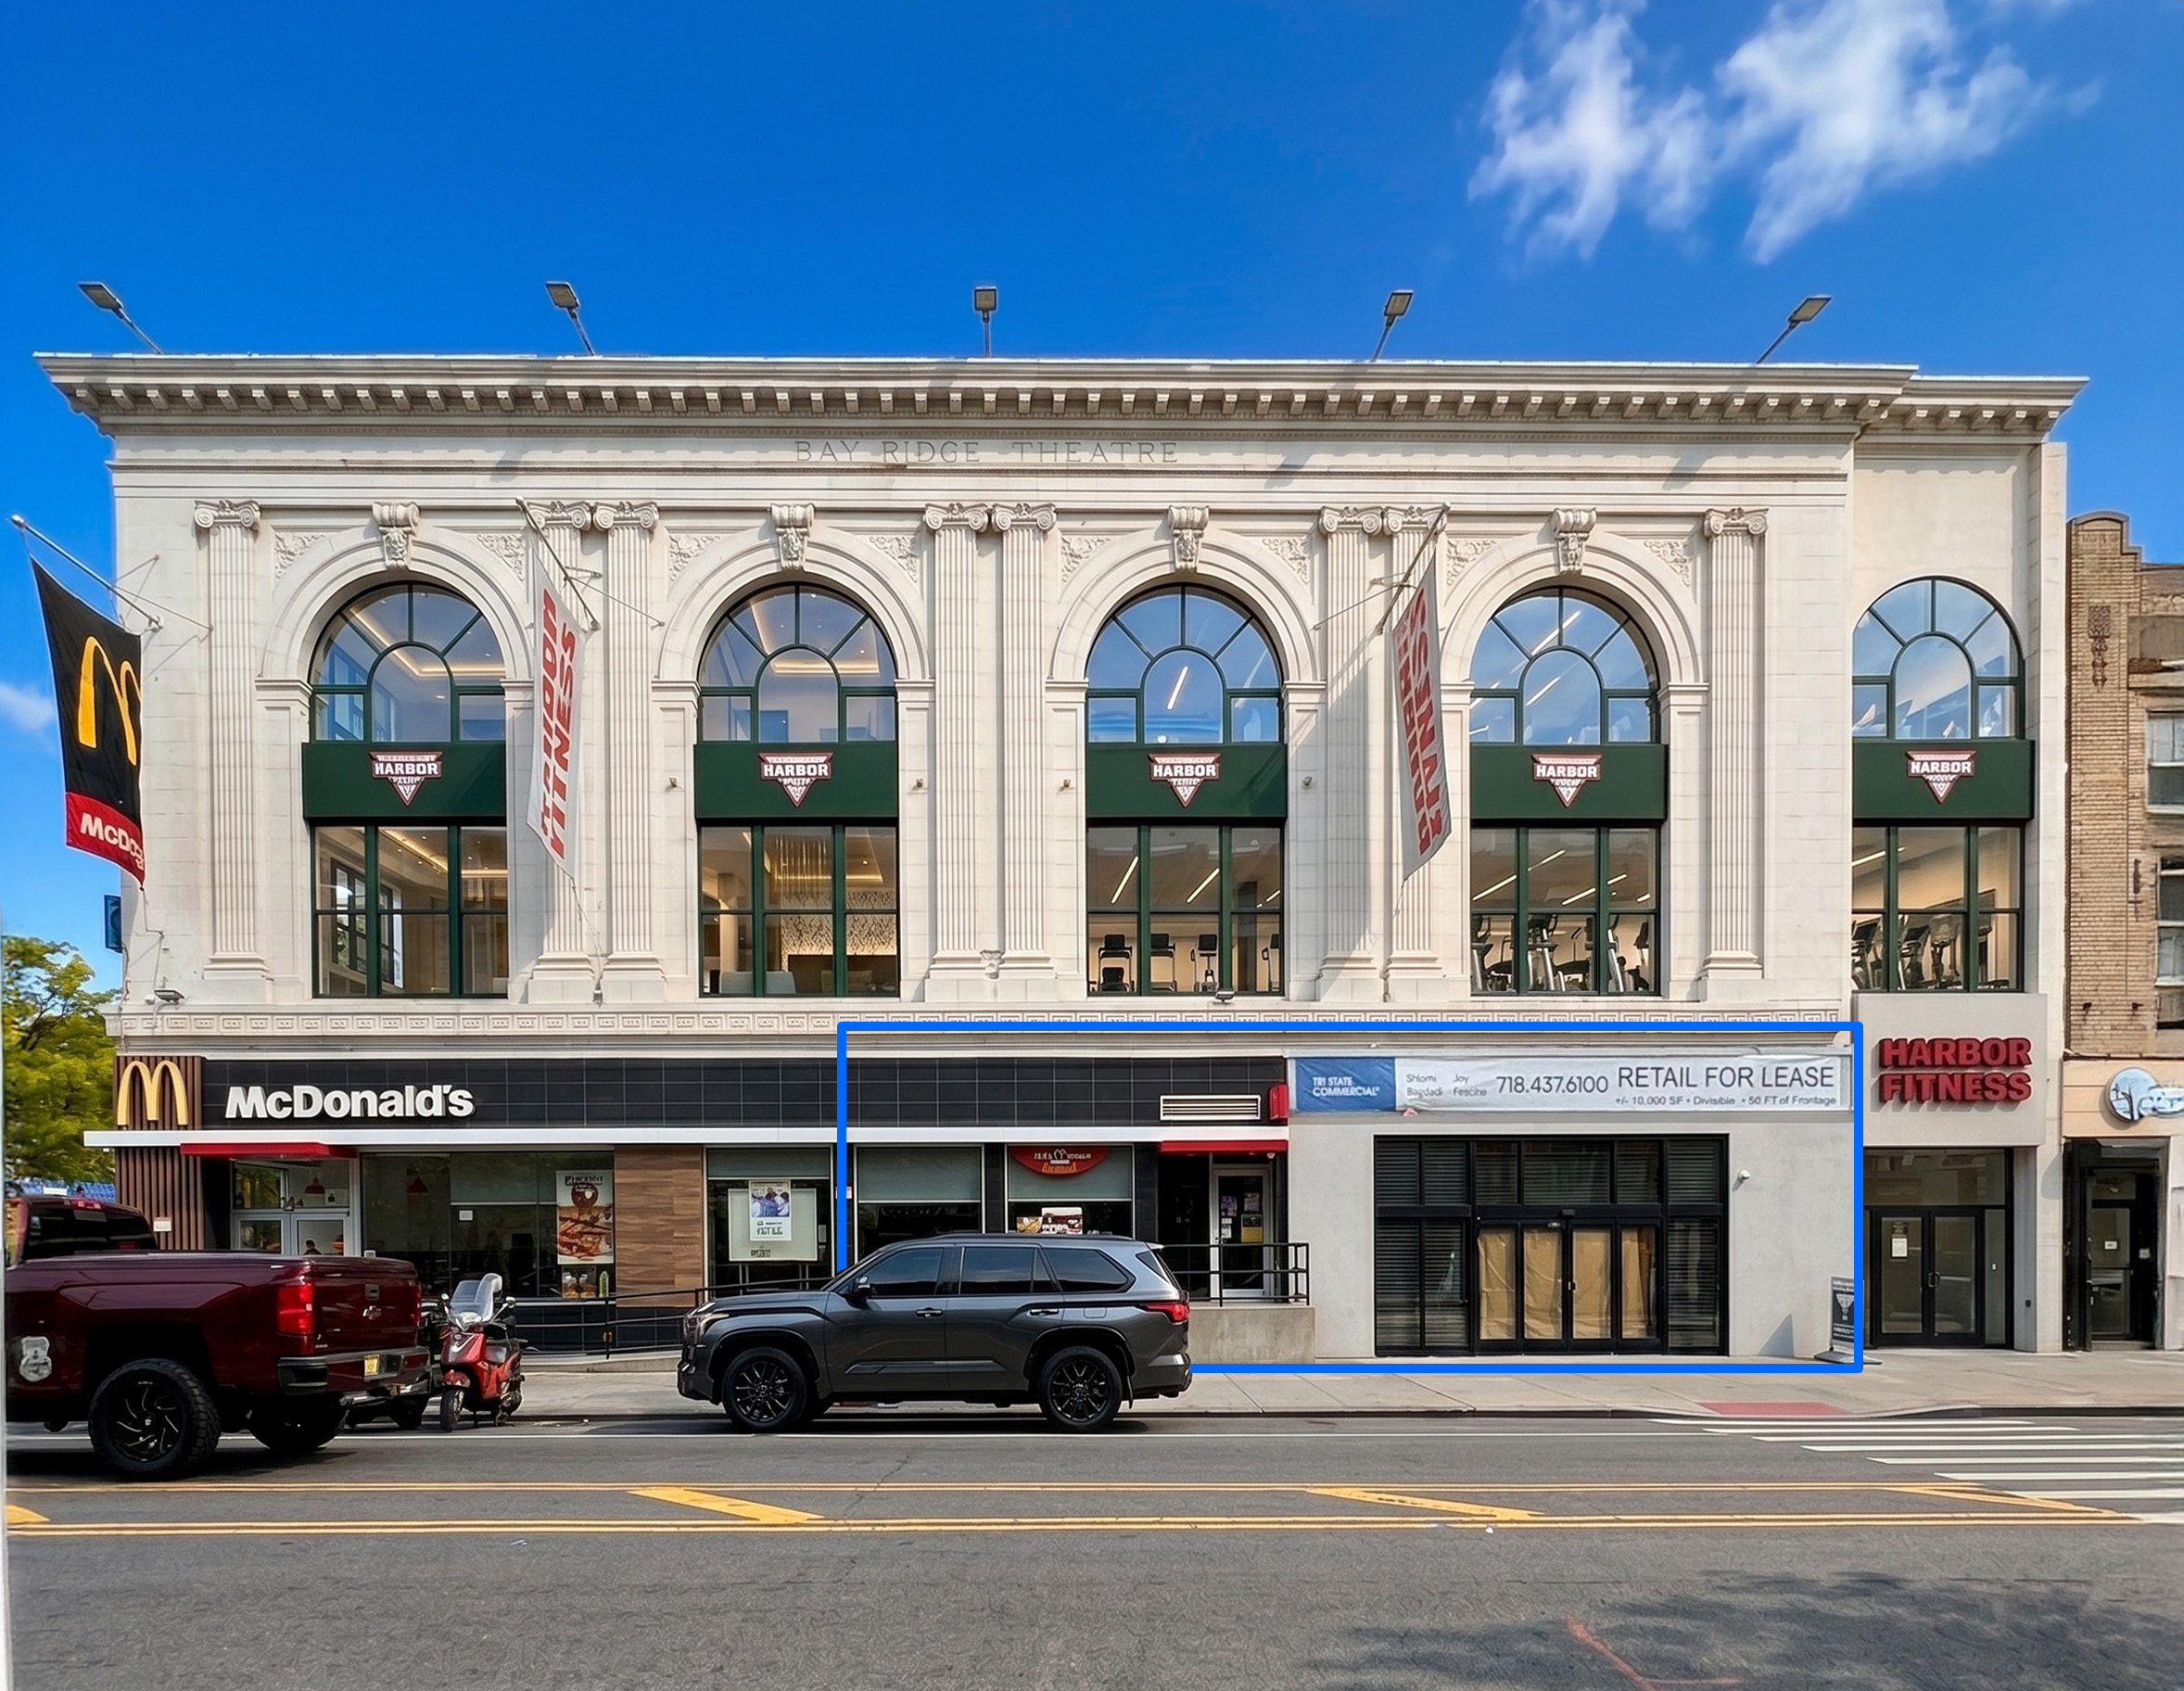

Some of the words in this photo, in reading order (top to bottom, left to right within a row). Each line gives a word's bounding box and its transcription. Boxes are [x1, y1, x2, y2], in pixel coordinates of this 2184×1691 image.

[794, 440, 860, 463] BAY
[881, 440, 981, 464] RIDGE
[1011, 441, 1178, 464] THEATRE
[375, 762, 439, 775] HARBOR
[763, 764, 830, 777] HARBOR
[1152, 764, 1217, 777] HARBOR
[1535, 765, 1598, 778] HARBOR
[1910, 761, 1972, 774] HARBOR
[1879, 1037, 2033, 1067] HARBOR
[1313, 1076, 1327, 1087] TRI
[1327, 1076, 1353, 1087] STATE
[1453, 1074, 1469, 1085] Joy
[1618, 1066, 1698, 1088] RETAIL
[1705, 1066, 1755, 1088] FOR
[1761, 1066, 1835, 1088] LEASE
[1496, 1075, 1609, 1094] 718.437.6100
[1879, 1072, 2033, 1103] FITNESS
[224, 1085, 475, 1119] McDonald's
[1669, 1095, 1683, 1105] SF
[1693, 1095, 1735, 1106] Divisible
[1747, 1095, 1761, 1106] 50
[1764, 1095, 1779, 1106] FT
[1779, 1095, 1790, 1106] of
[1791, 1096, 1837, 1109] Frontage
